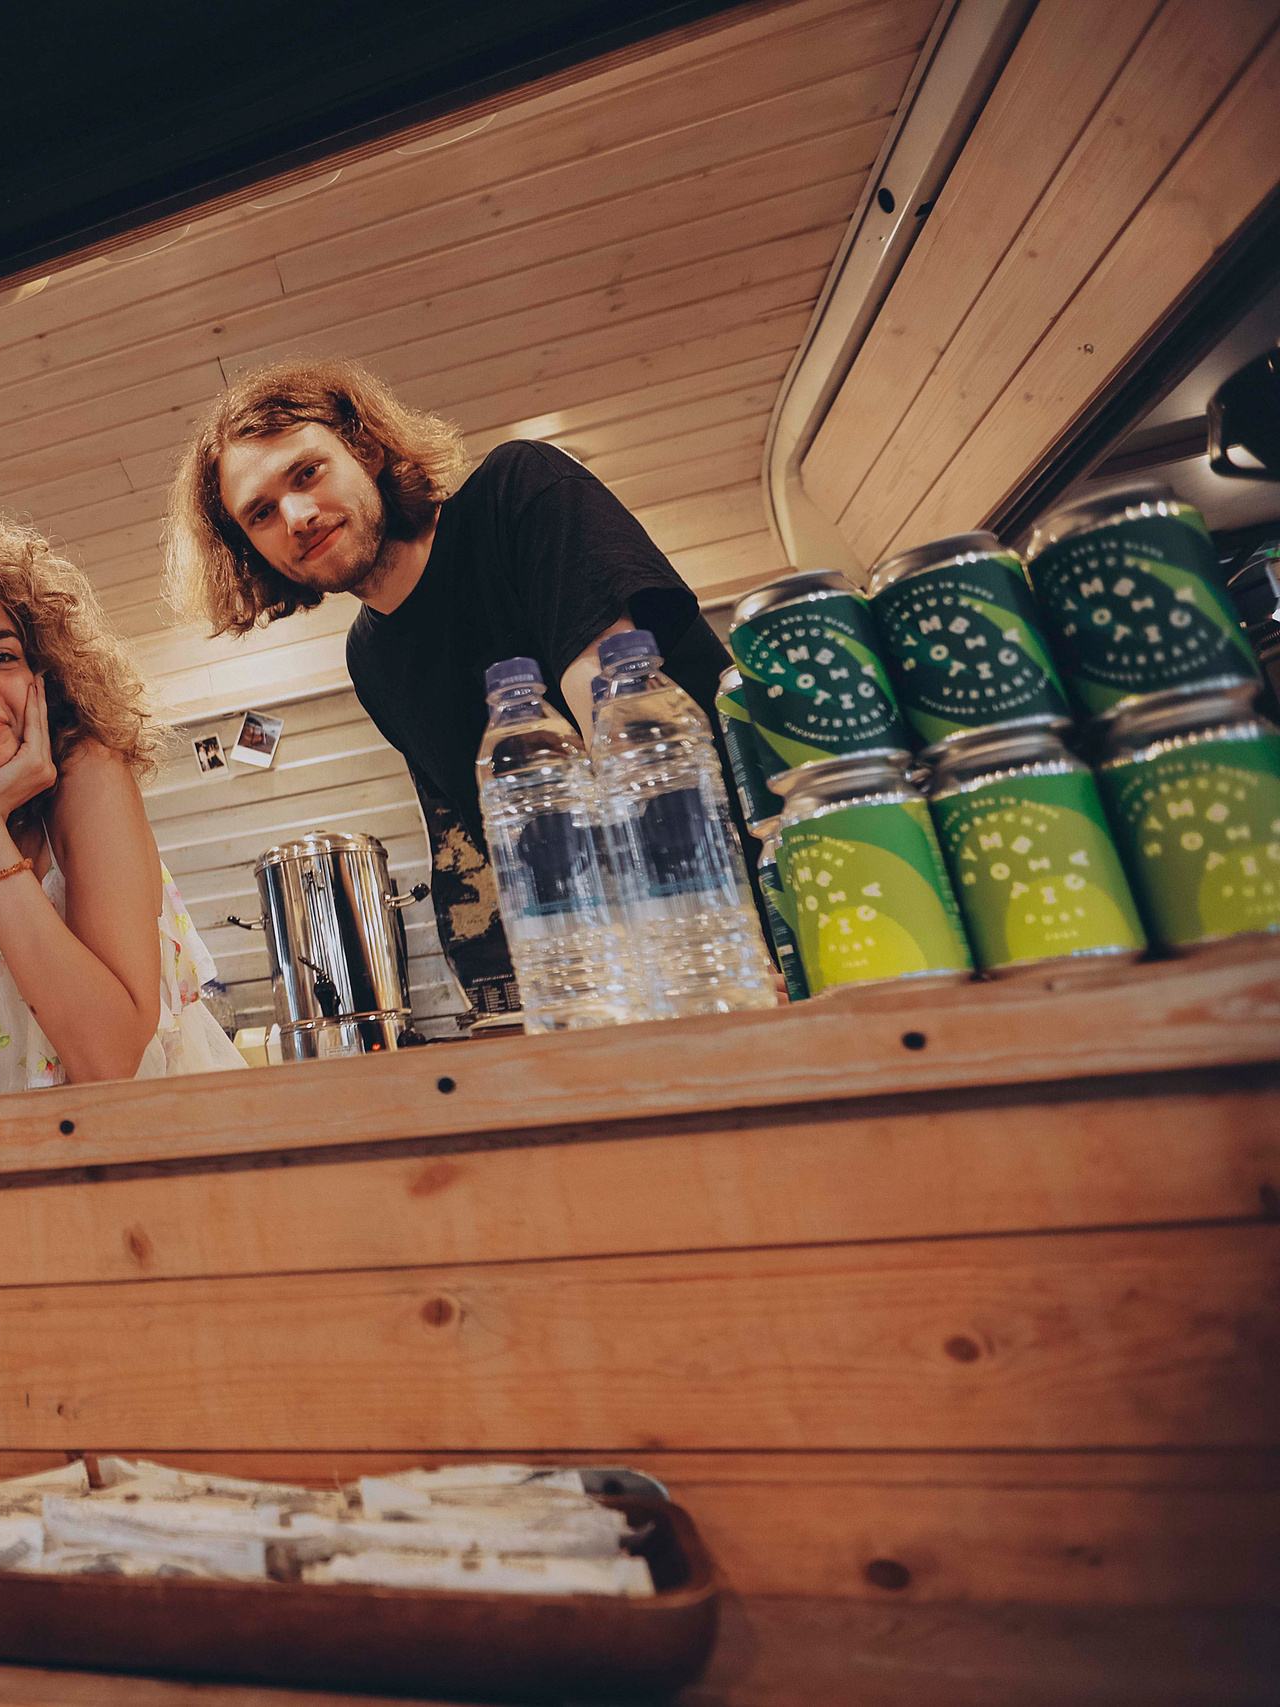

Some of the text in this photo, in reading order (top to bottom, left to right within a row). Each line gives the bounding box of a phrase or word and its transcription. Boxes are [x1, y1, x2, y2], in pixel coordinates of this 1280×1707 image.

[889, 595, 983, 642] KOMBUCHA
[754, 627, 846, 670] KOMBUCHA
[942, 667, 1033, 699] VIBRANT
[807, 701, 887, 728] VIBRANT
